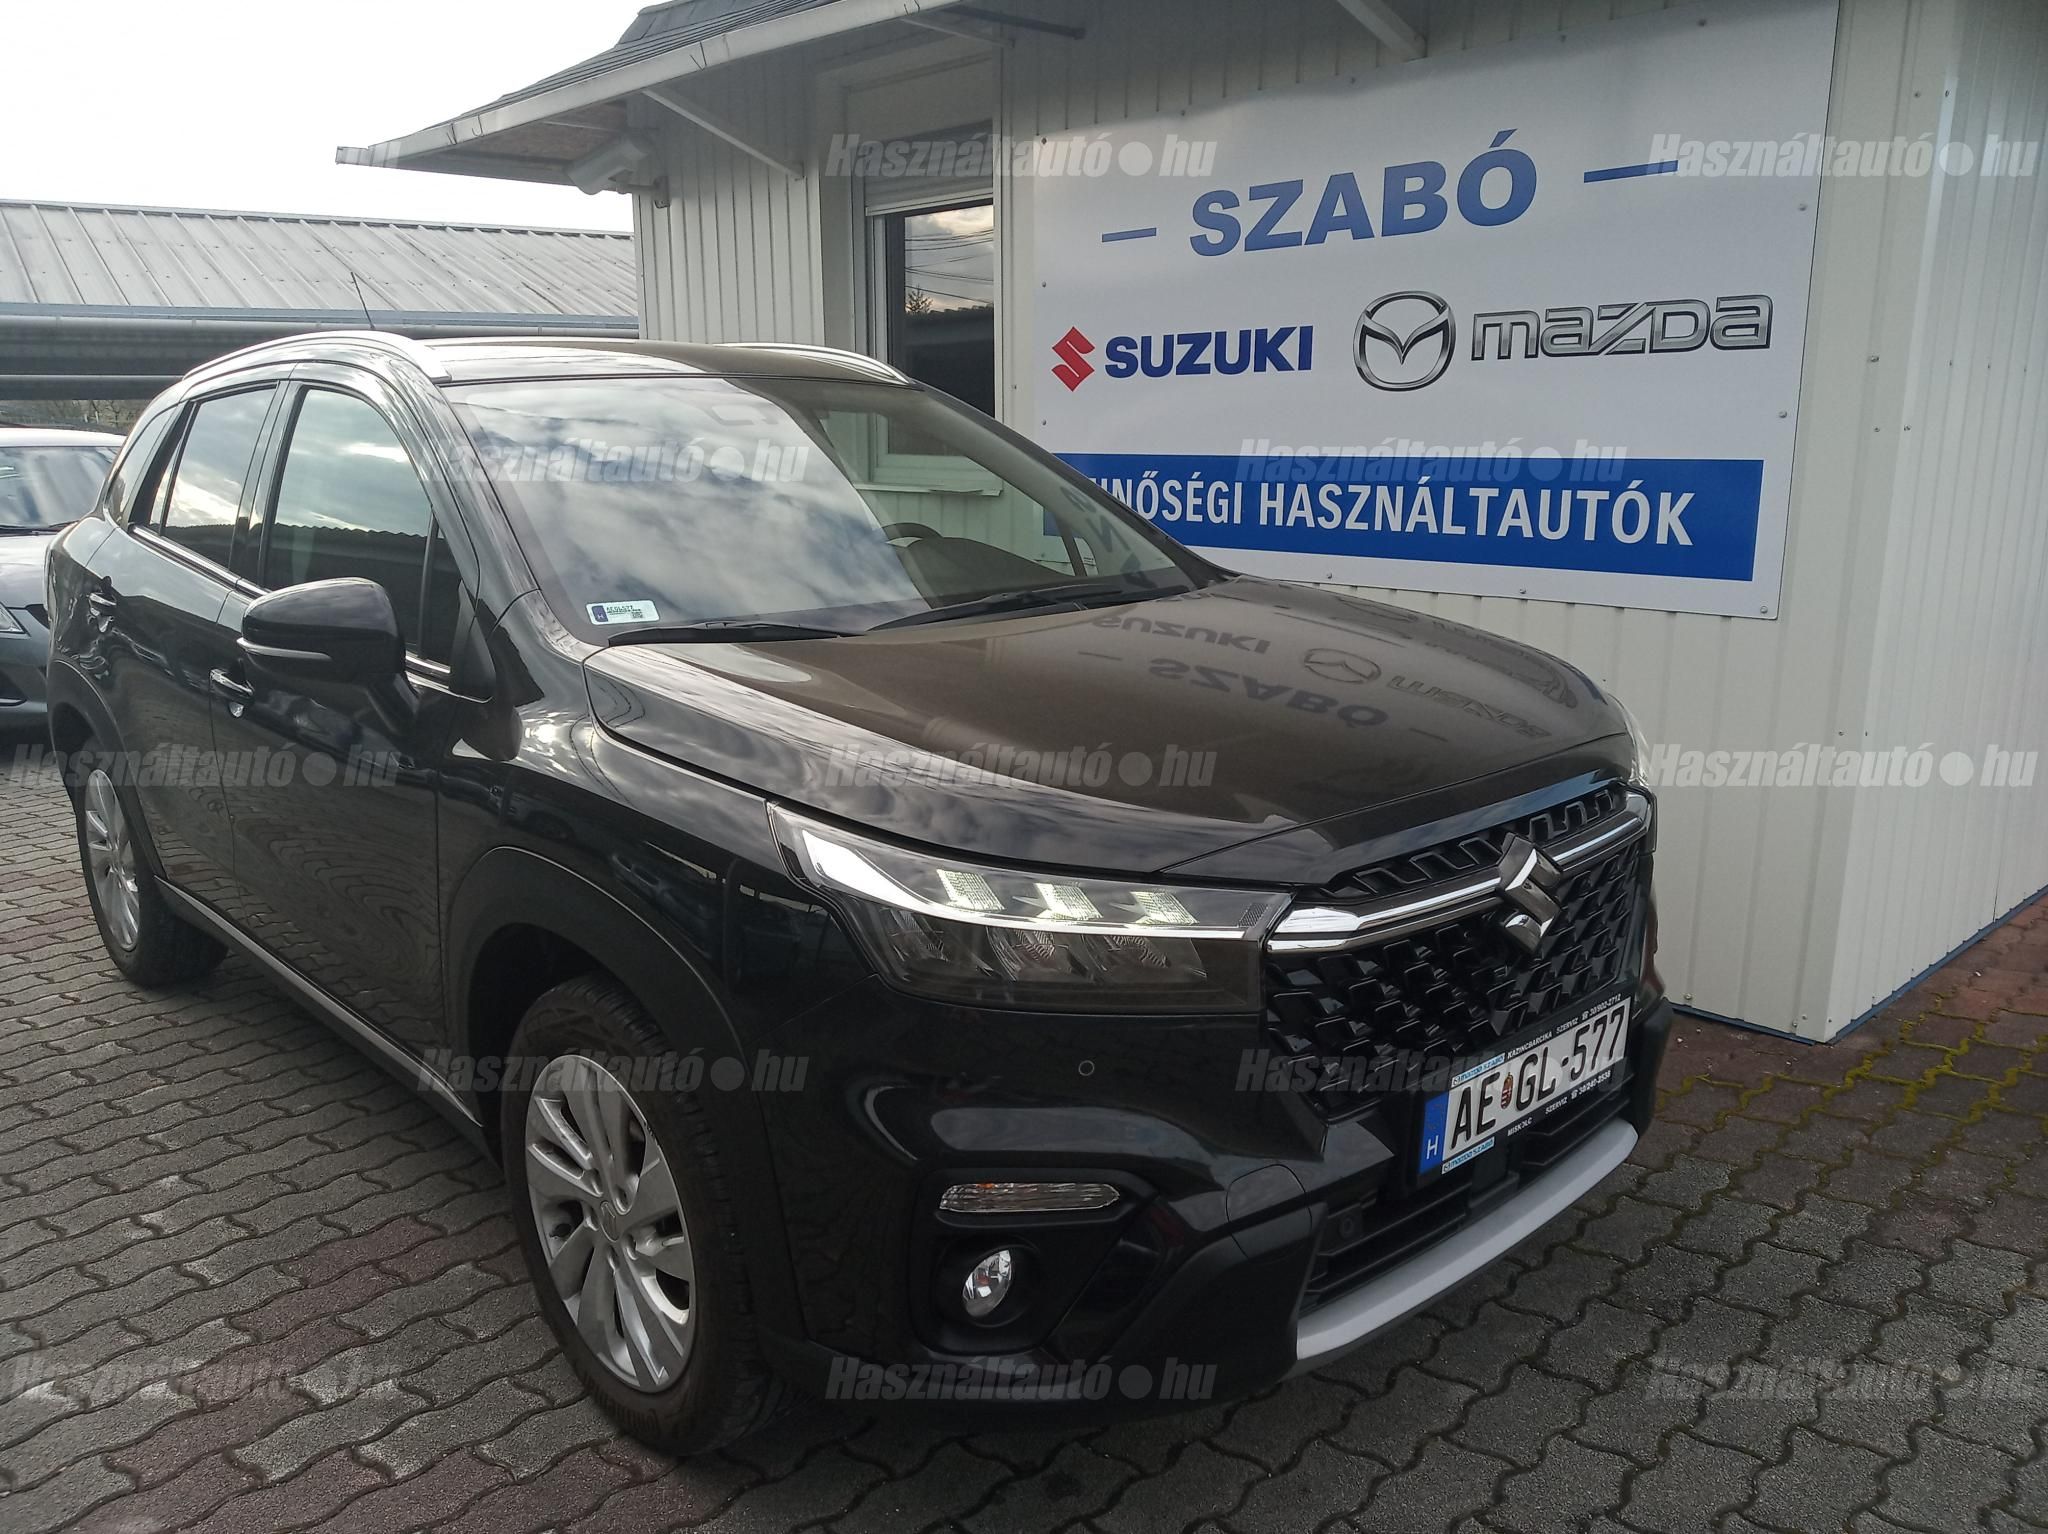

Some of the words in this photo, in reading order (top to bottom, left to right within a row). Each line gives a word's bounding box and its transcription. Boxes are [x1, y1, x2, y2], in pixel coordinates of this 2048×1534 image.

[1191, 128, 1537, 257] SZABÓ
[1106, 325, 1313, 379] SUZUKI
[1088, 470, 1243, 524] NŐSÉGI
[1259, 476, 1695, 546] HASZNÁLTAUTÓK
[1426, 1135, 1439, 1160] H
